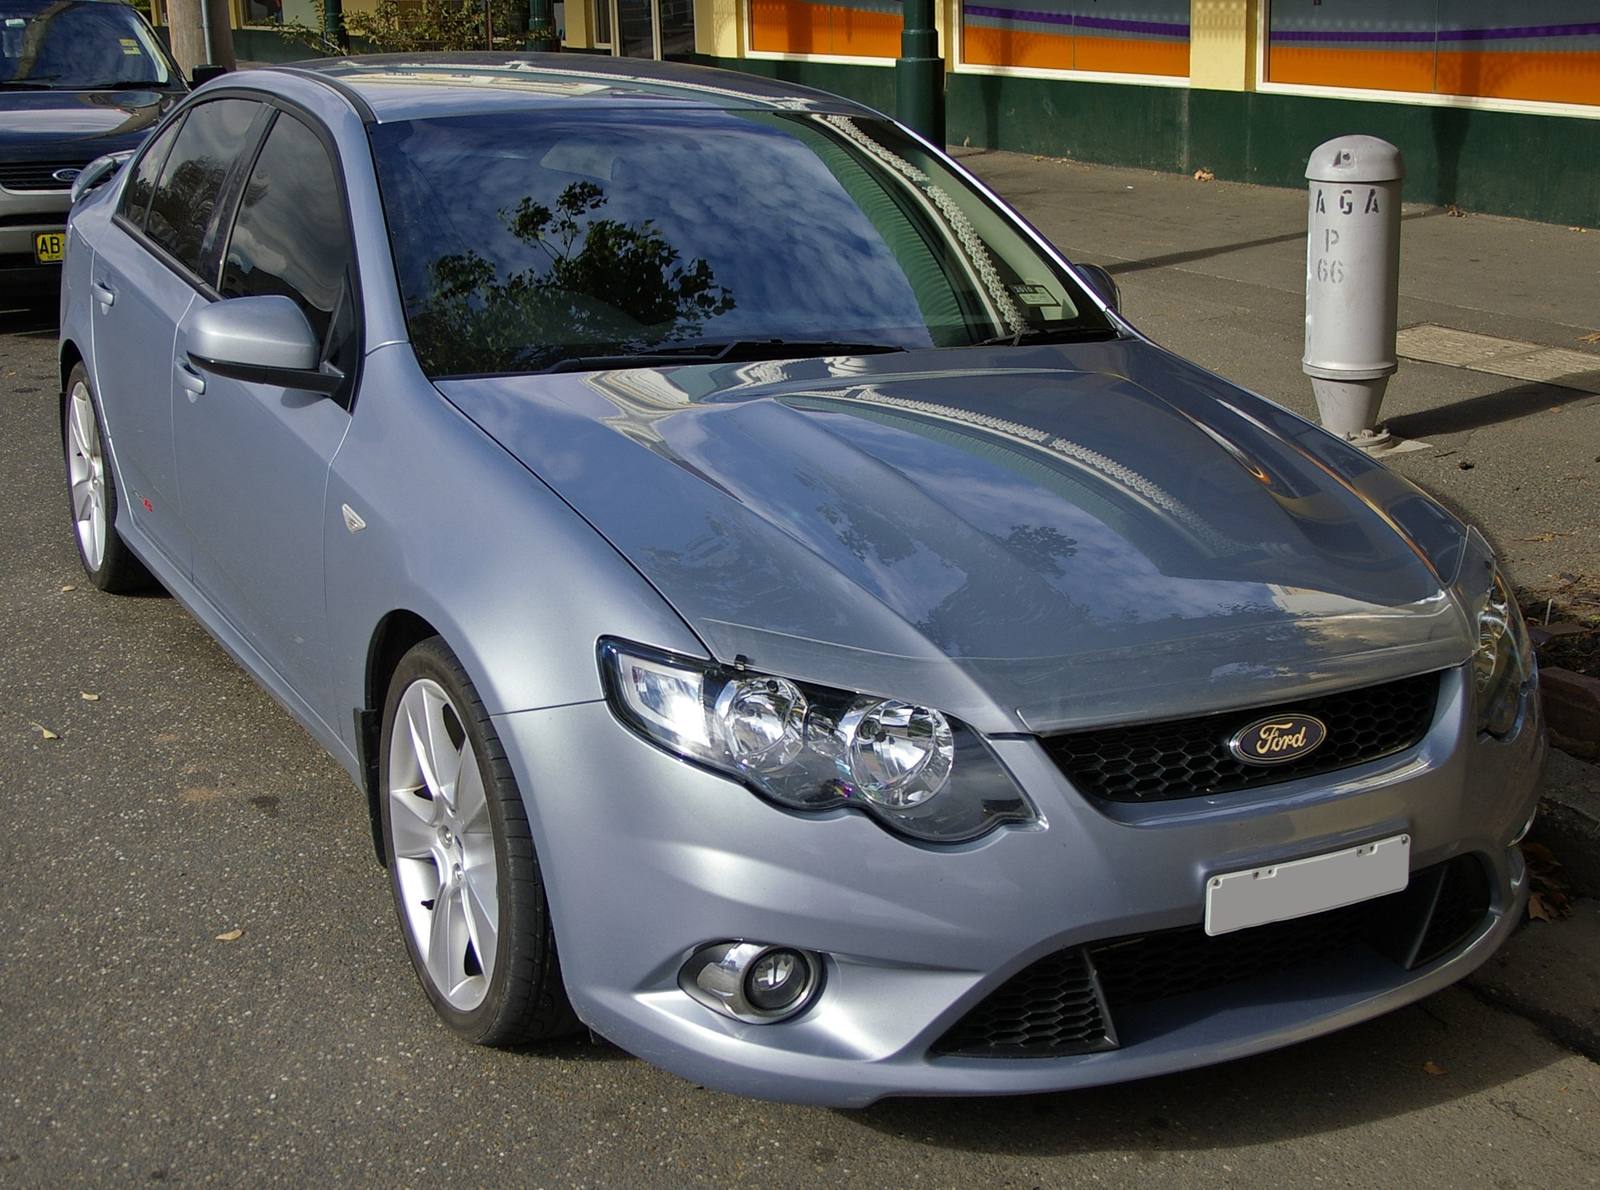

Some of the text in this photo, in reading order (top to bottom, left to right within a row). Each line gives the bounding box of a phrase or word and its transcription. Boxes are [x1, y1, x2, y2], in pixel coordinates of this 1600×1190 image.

[1325, 228, 1340, 252] P
[1317, 258, 1345, 283] 66
[1256, 722, 1307, 754] Ford
